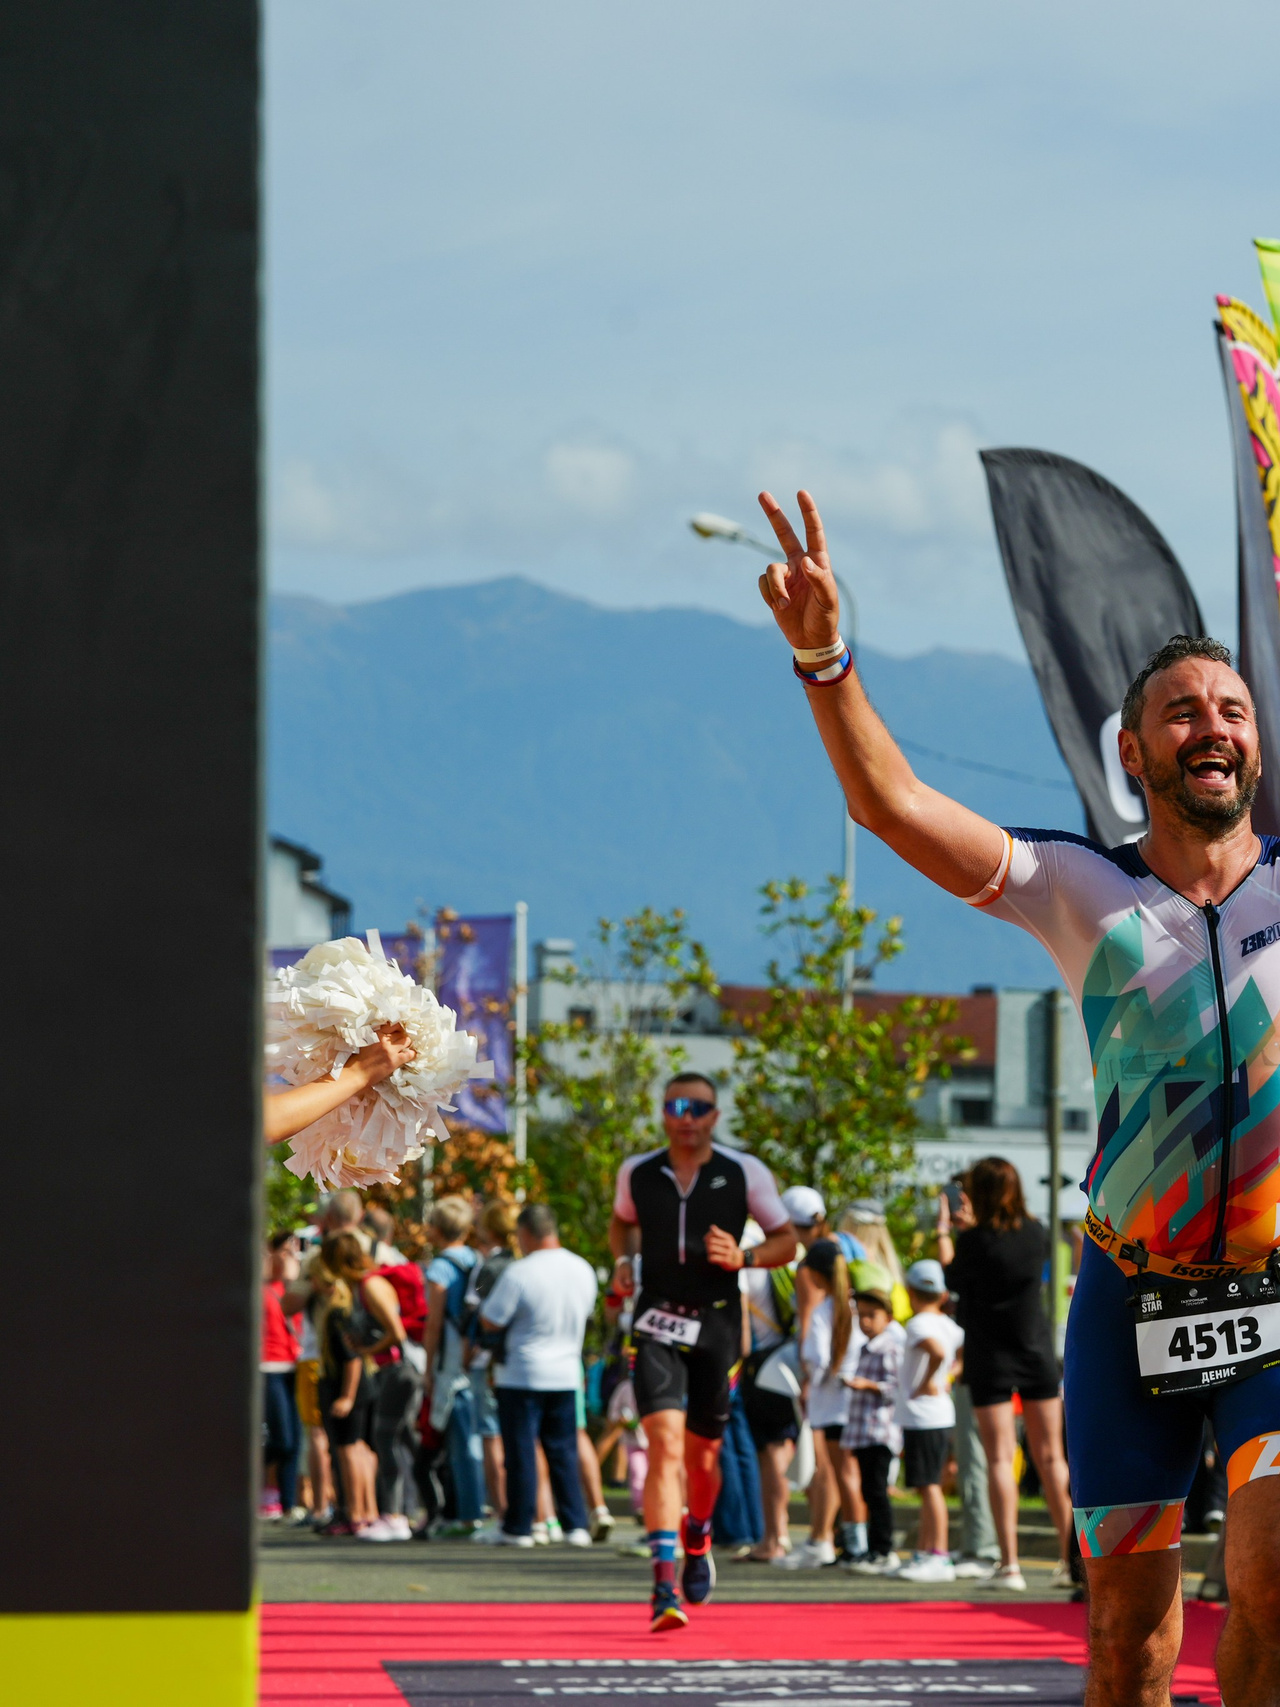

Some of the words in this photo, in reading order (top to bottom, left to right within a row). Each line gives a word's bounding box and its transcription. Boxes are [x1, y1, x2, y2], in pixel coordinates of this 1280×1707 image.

[1170, 1263, 1247, 1279] isostar
[1141, 1300, 1163, 1313] STAR
[1168, 1316, 1262, 1362] 4513
[1201, 1366, 1237, 1384] ДЕНИС
